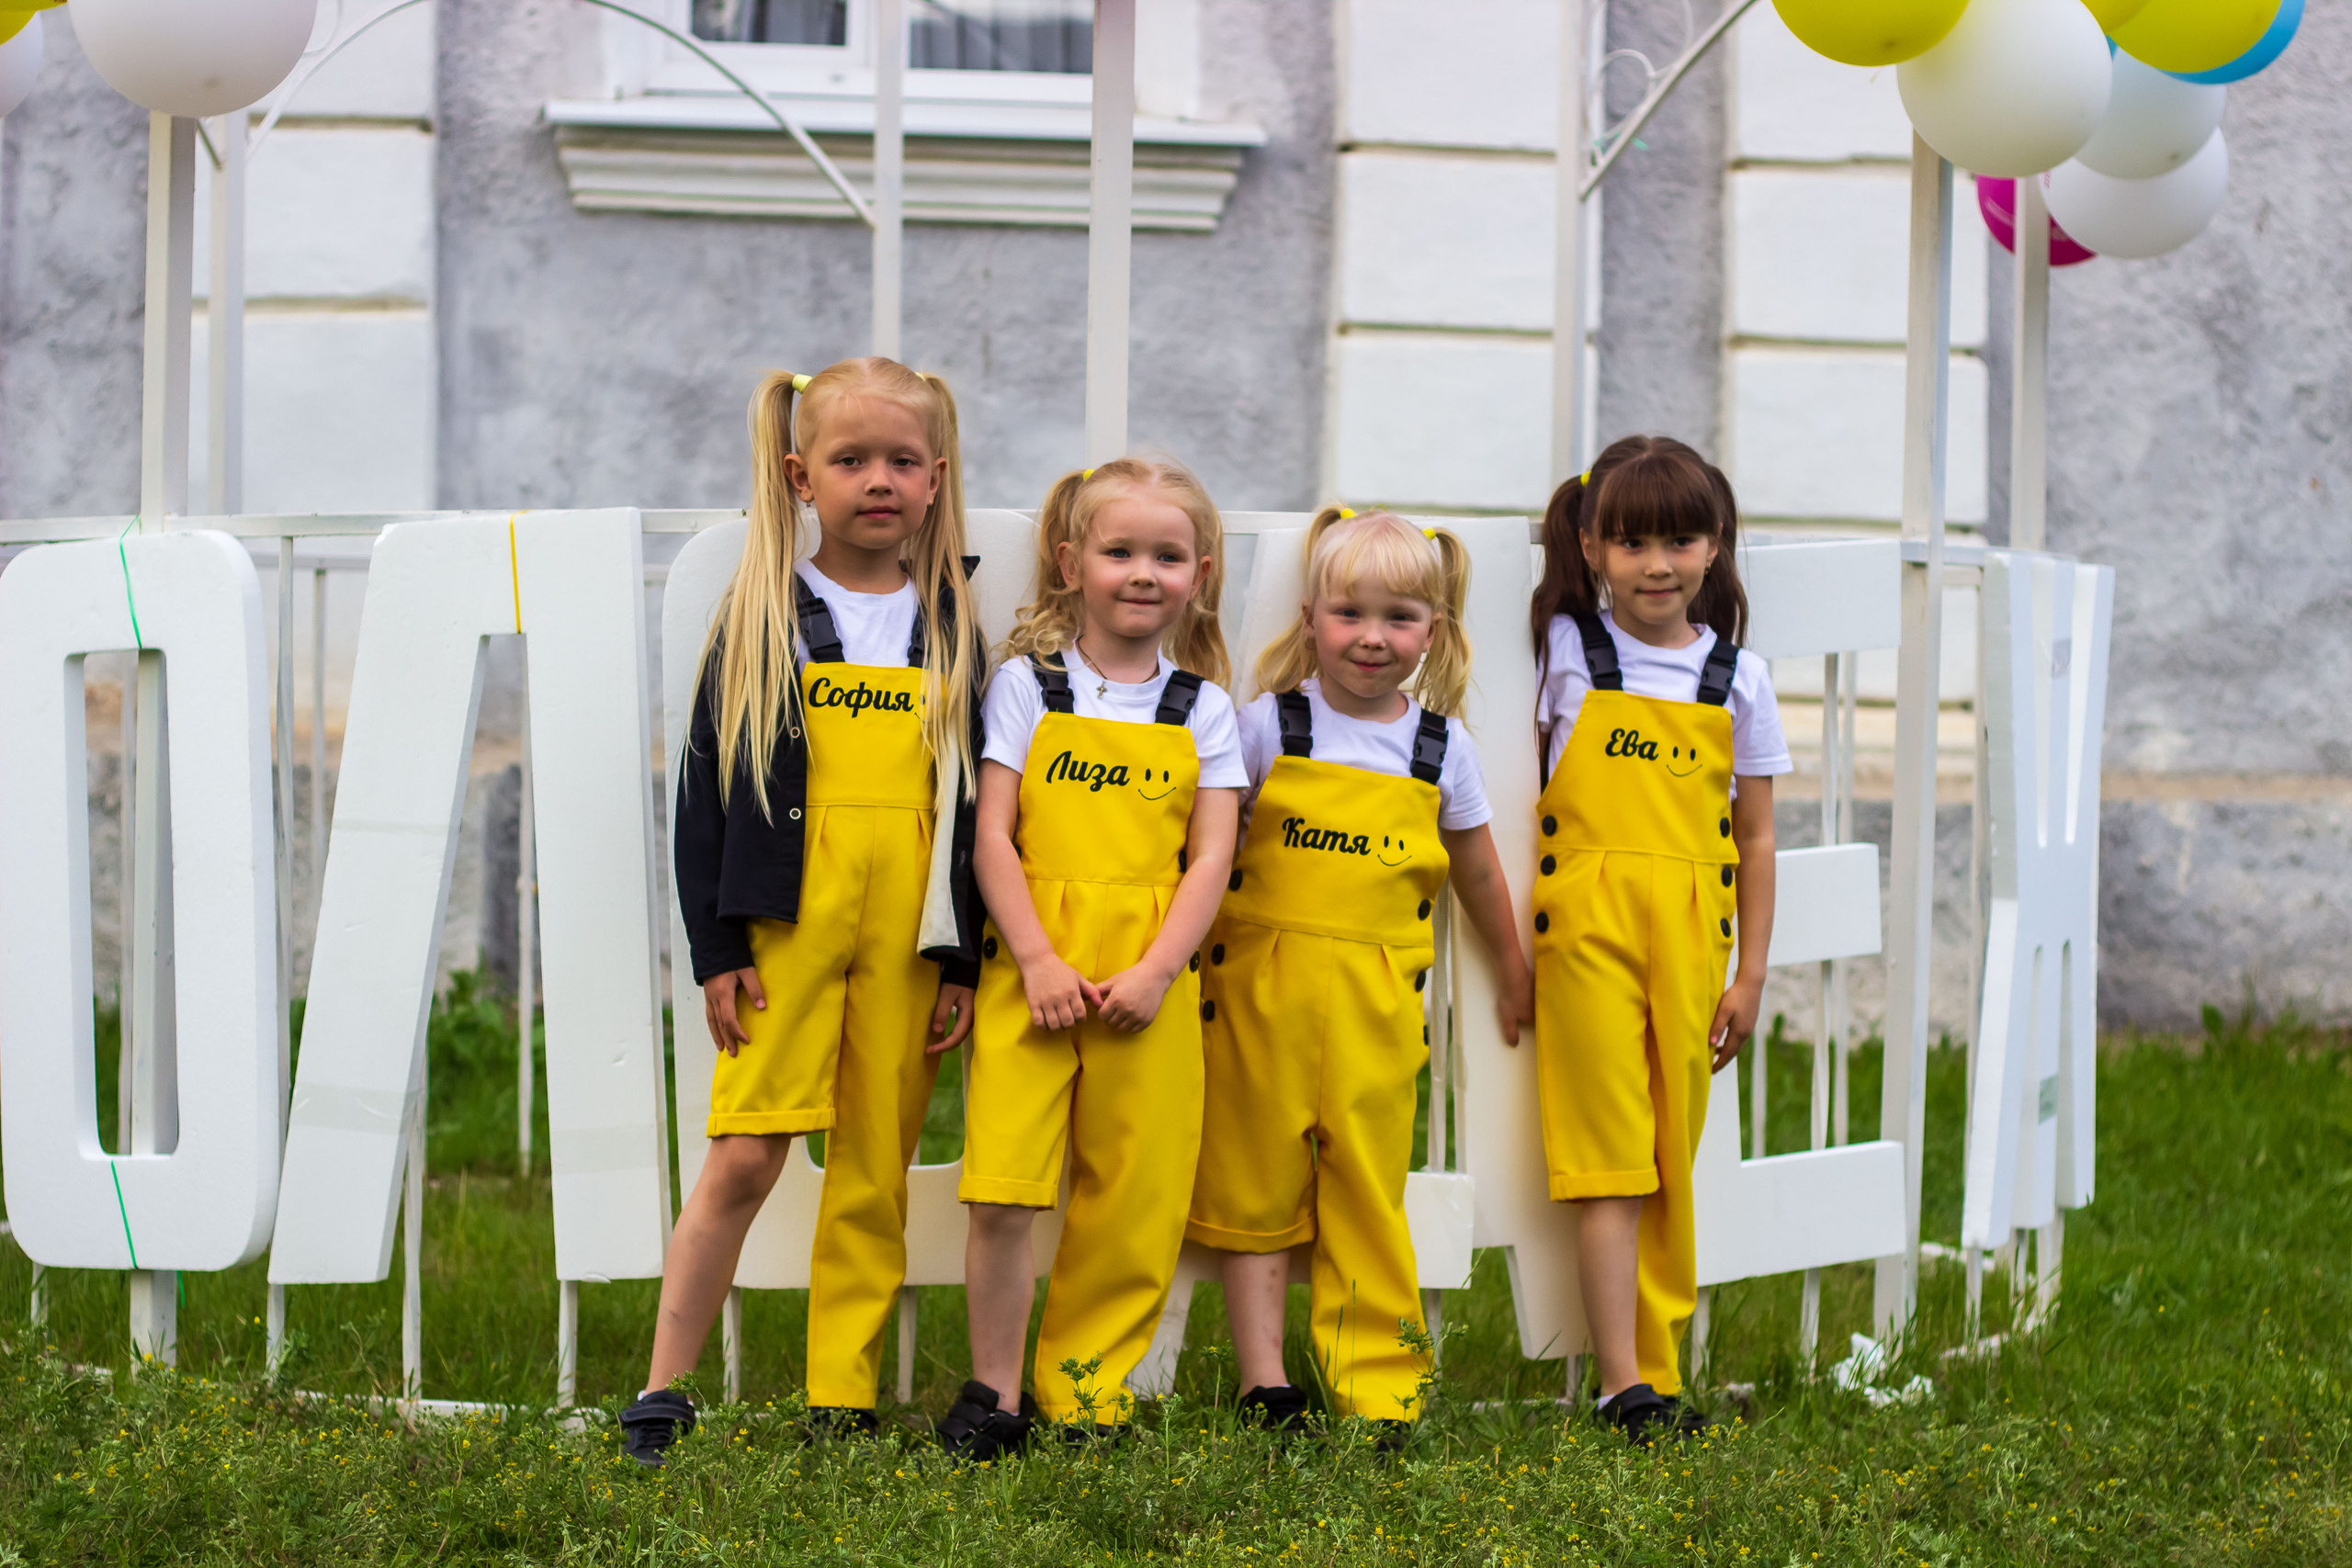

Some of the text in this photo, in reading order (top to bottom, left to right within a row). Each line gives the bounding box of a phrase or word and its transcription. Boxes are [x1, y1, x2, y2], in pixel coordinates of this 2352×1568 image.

[808, 677, 914, 718] София
[1605, 728, 1659, 761] Ева
[1046, 750, 1130, 792] Лиза
[1282, 817, 1371, 855] Катя
